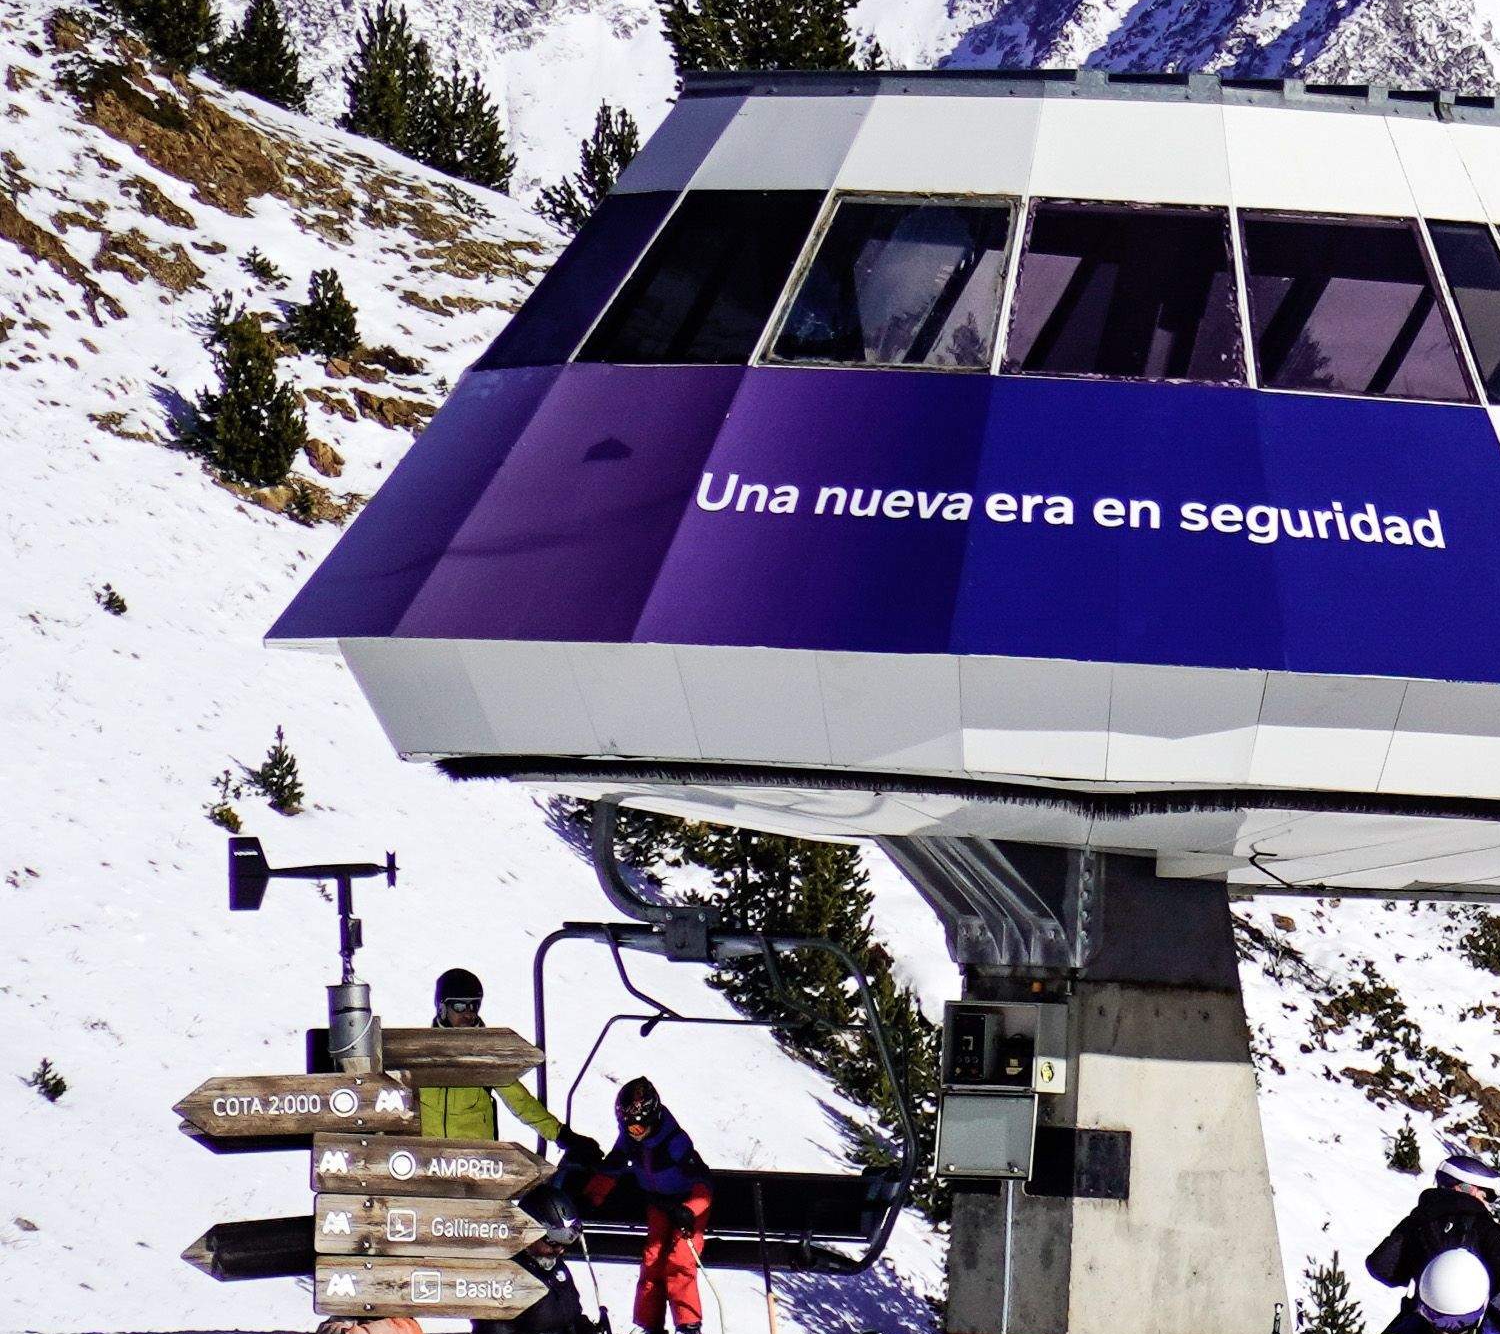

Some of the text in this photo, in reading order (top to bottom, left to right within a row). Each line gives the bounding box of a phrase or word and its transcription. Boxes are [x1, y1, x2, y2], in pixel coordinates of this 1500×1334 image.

[695, 472, 1447, 551] Una nueva era en seguridad
[212, 1094, 322, 1117] COTA 2.000
[428, 1157, 503, 1179] AMPRIU
[431, 1217, 509, 1239] Gallinero
[455, 1277, 513, 1299] Basibé
